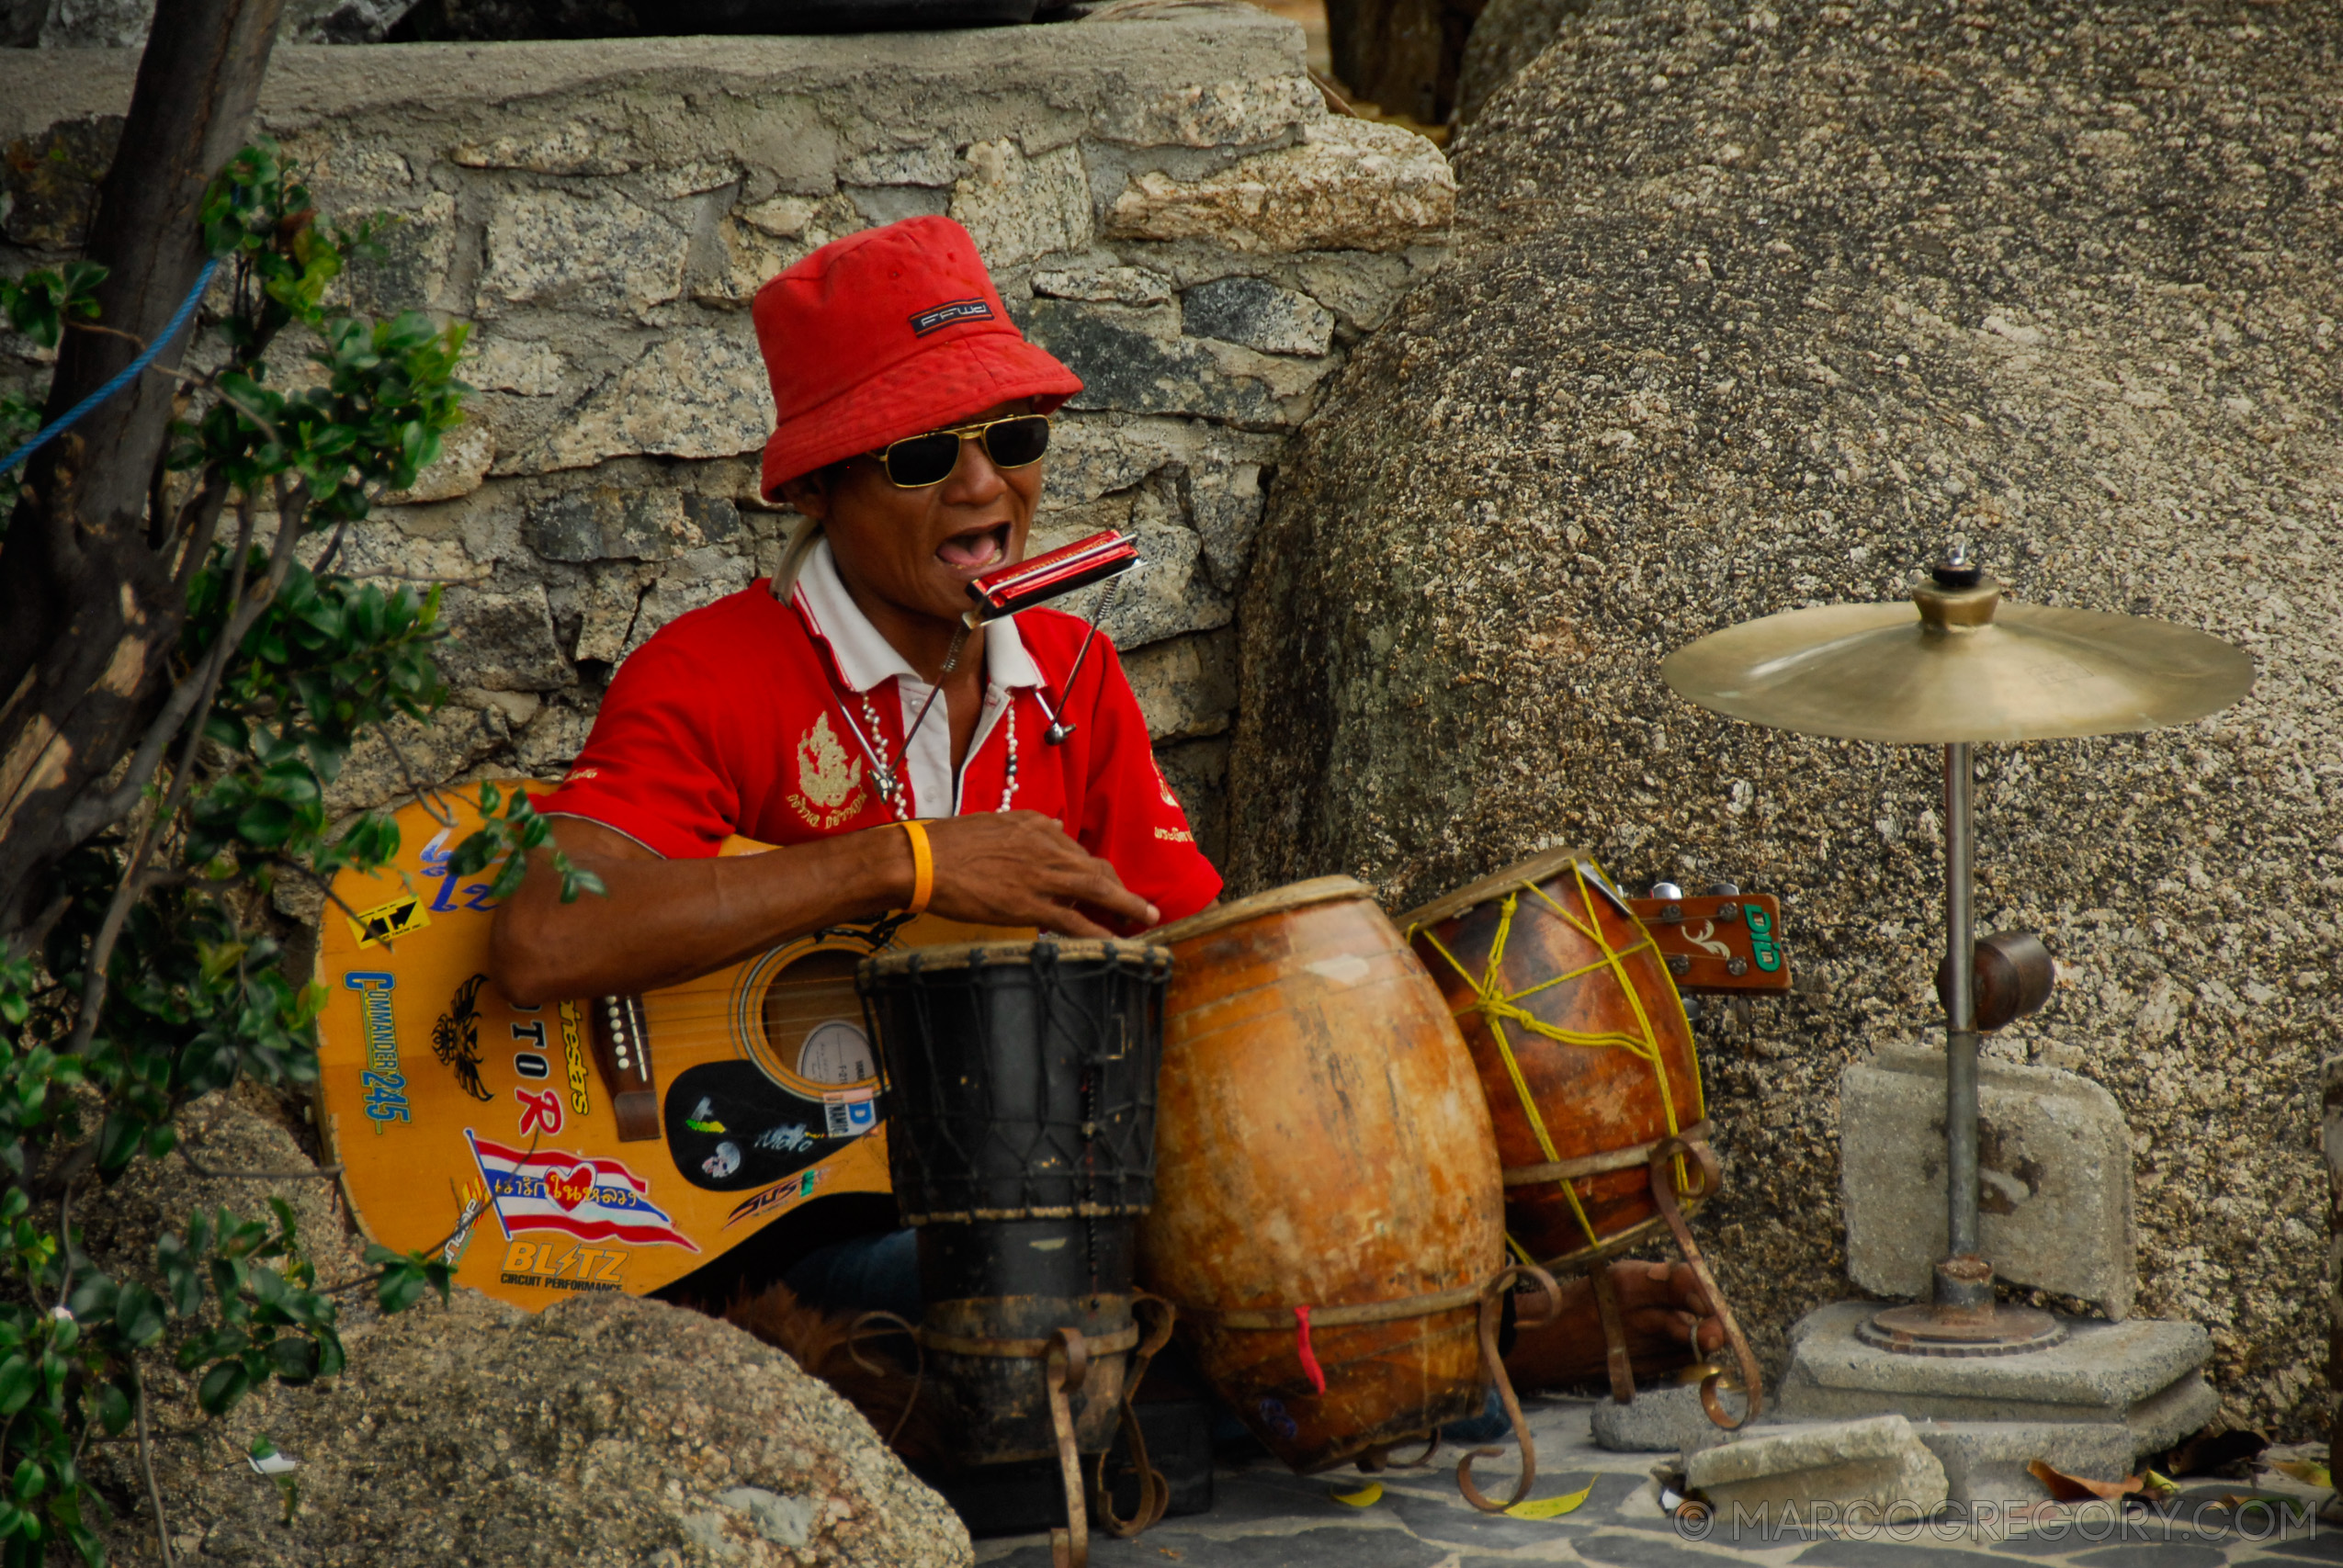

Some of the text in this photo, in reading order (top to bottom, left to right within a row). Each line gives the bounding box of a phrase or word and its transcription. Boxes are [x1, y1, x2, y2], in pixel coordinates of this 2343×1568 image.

[343, 970, 398, 1070] COMMANDER
[360, 1069, 412, 1123] 245
[510, 1001, 564, 1137] TOR
[500, 1272, 623, 1292] CIRCUIT PERFORMANCE
